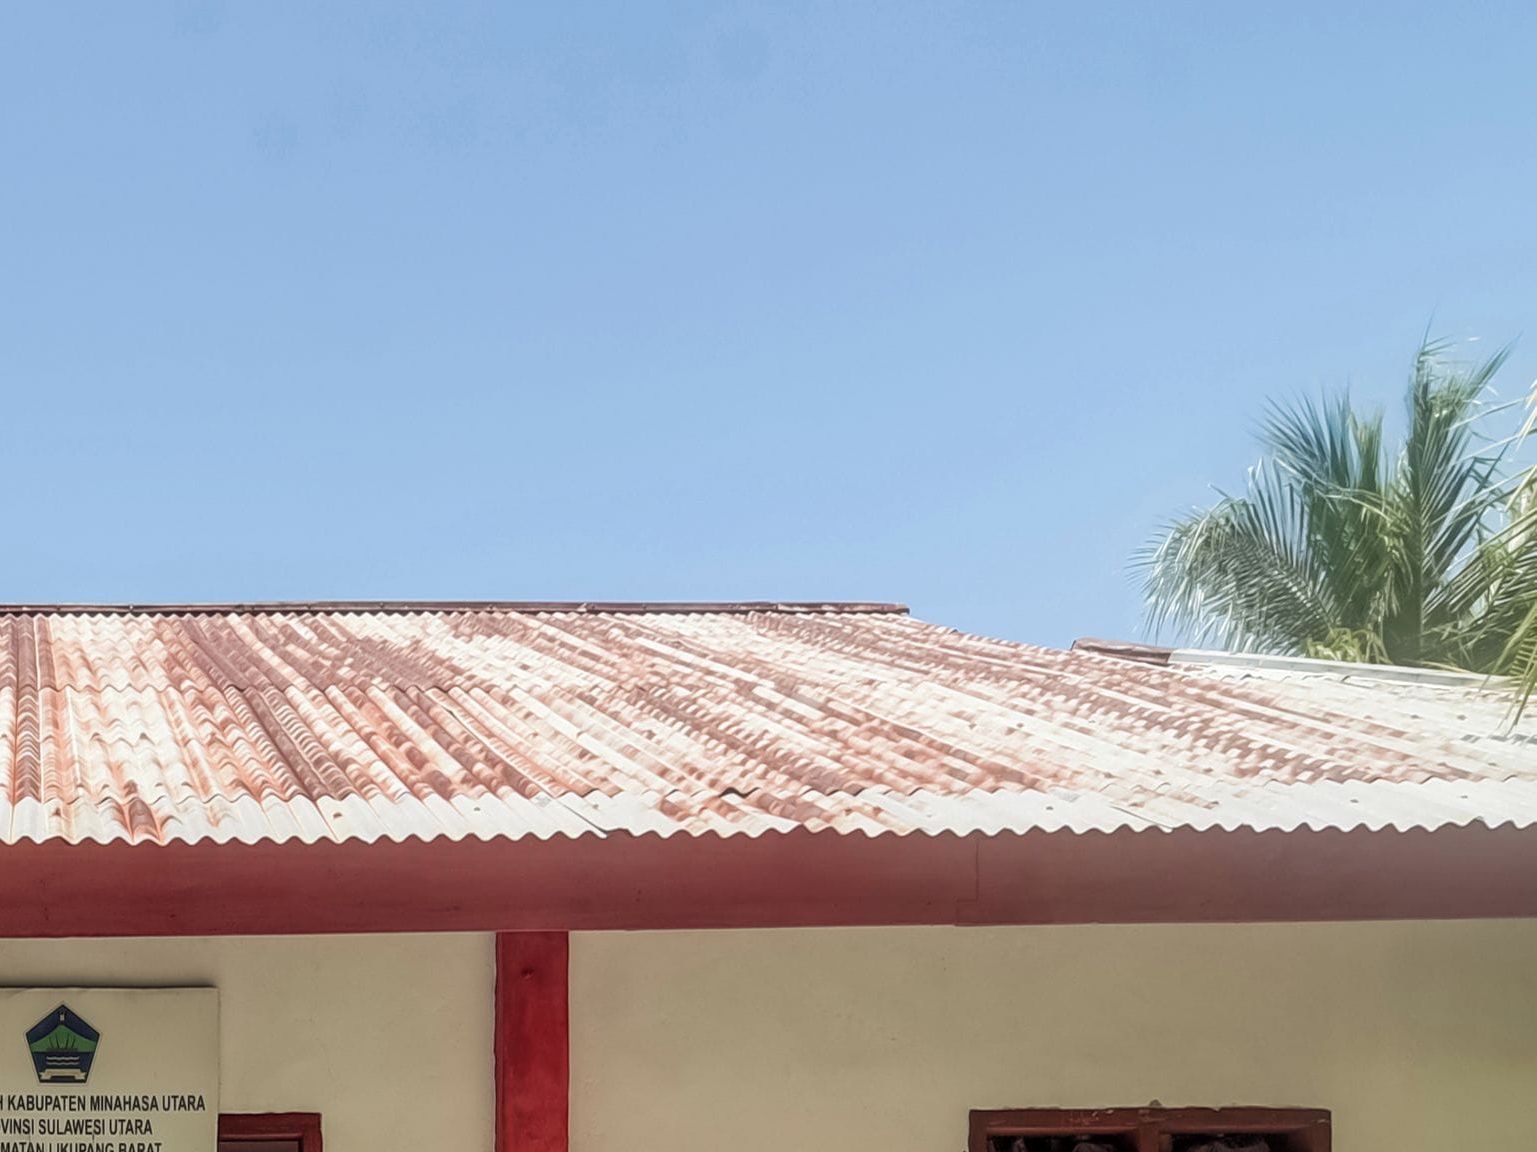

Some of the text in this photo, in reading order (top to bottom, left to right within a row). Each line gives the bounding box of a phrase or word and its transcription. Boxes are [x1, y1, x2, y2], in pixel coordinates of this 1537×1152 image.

[8, 1095, 86, 1111] KABUPATEN
[90, 1095, 159, 1112] MINAHASA
[162, 1095, 206, 1111] UTARA
[38, 1119, 105, 1135] SULAWESI
[109, 1119, 153, 1135] UTARA
